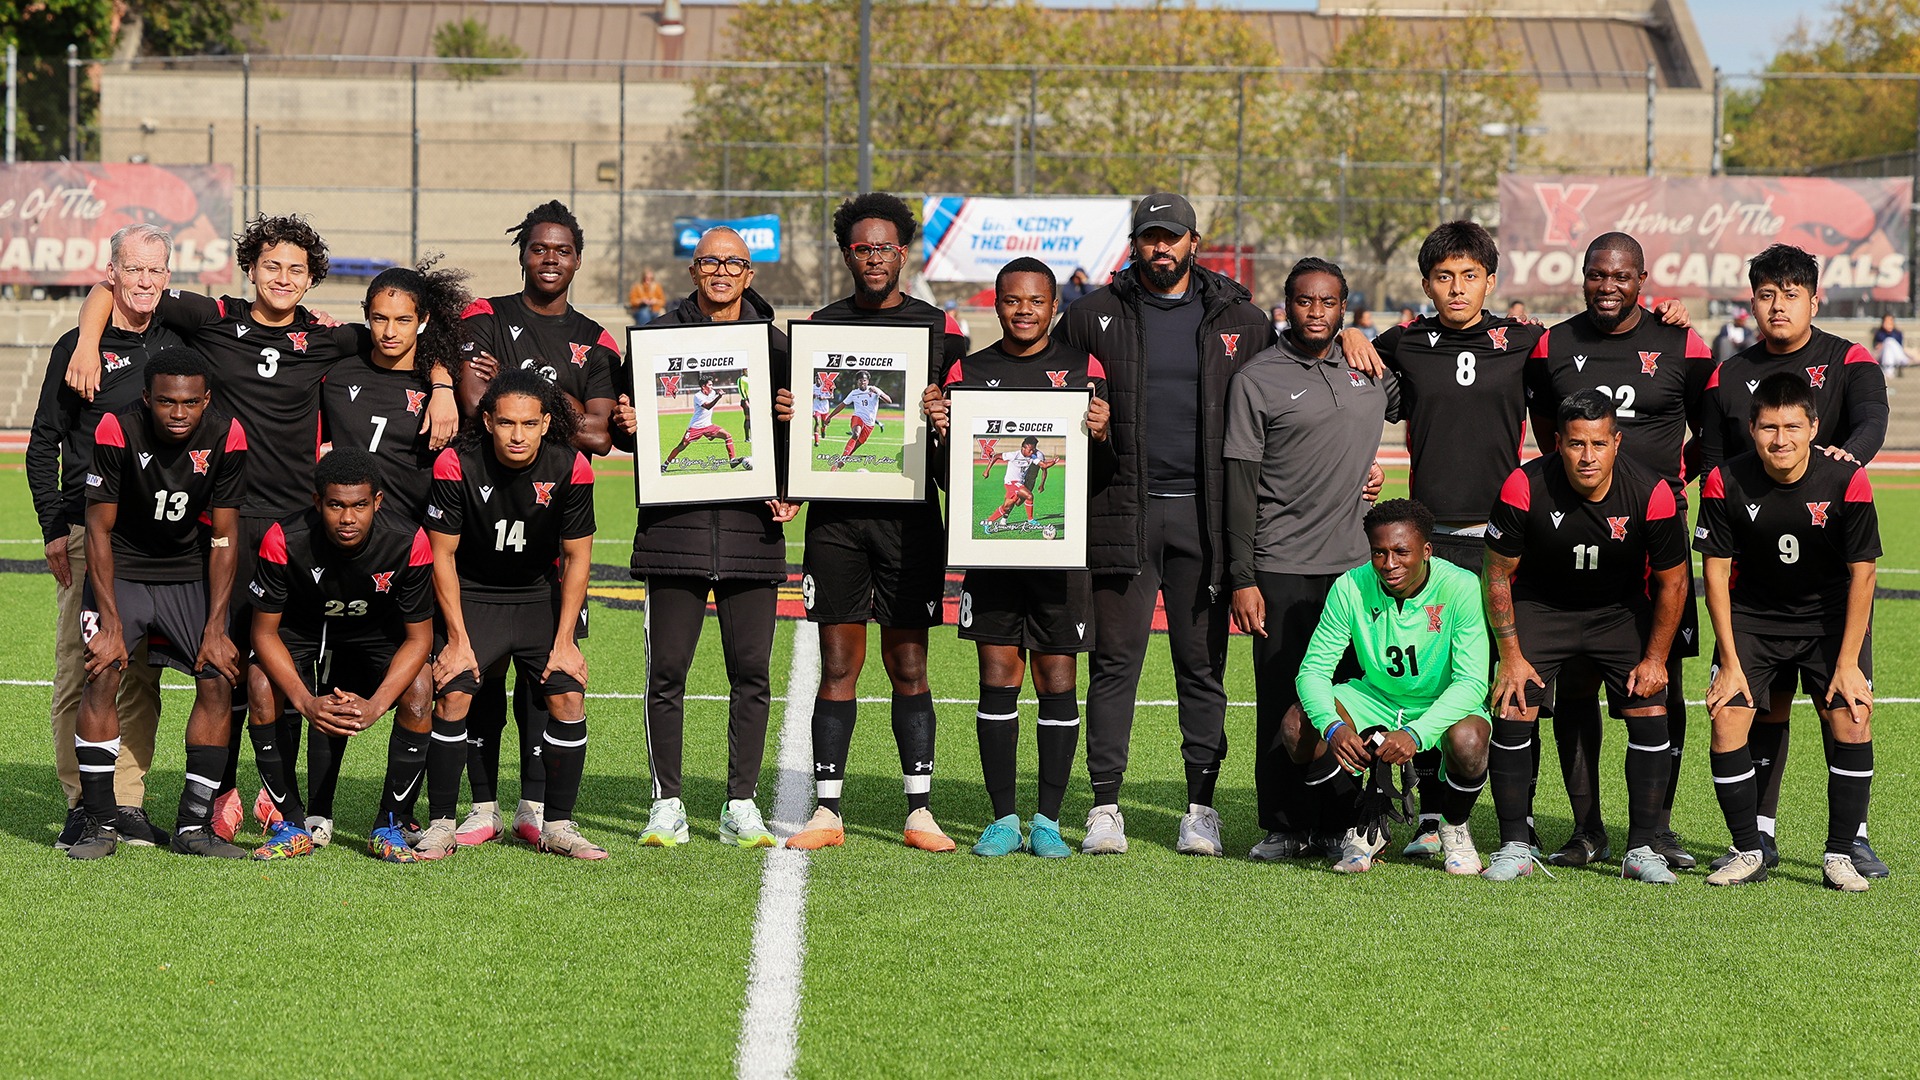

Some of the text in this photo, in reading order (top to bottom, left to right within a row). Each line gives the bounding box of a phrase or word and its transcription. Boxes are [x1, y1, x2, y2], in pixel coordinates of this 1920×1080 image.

[59, 179, 107, 220] The
[1614, 195, 1786, 249] Home Of The
[1508, 250, 1585, 286] YO
[257, 347, 279, 378] 3
[699, 356, 735, 368] SOCCER
[858, 357, 894, 367] SOCCER
[1456, 351, 1476, 386] 8
[369, 416, 388, 453] 7
[1018, 422, 1054, 432] SOCCER
[154, 489, 189, 521] 13
[494, 519, 527, 552] 14
[1778, 533, 1800, 564] 9
[1572, 544, 1600, 570] 11
[324, 600, 369, 617] 23
[1386, 645, 1419, 678] 31
